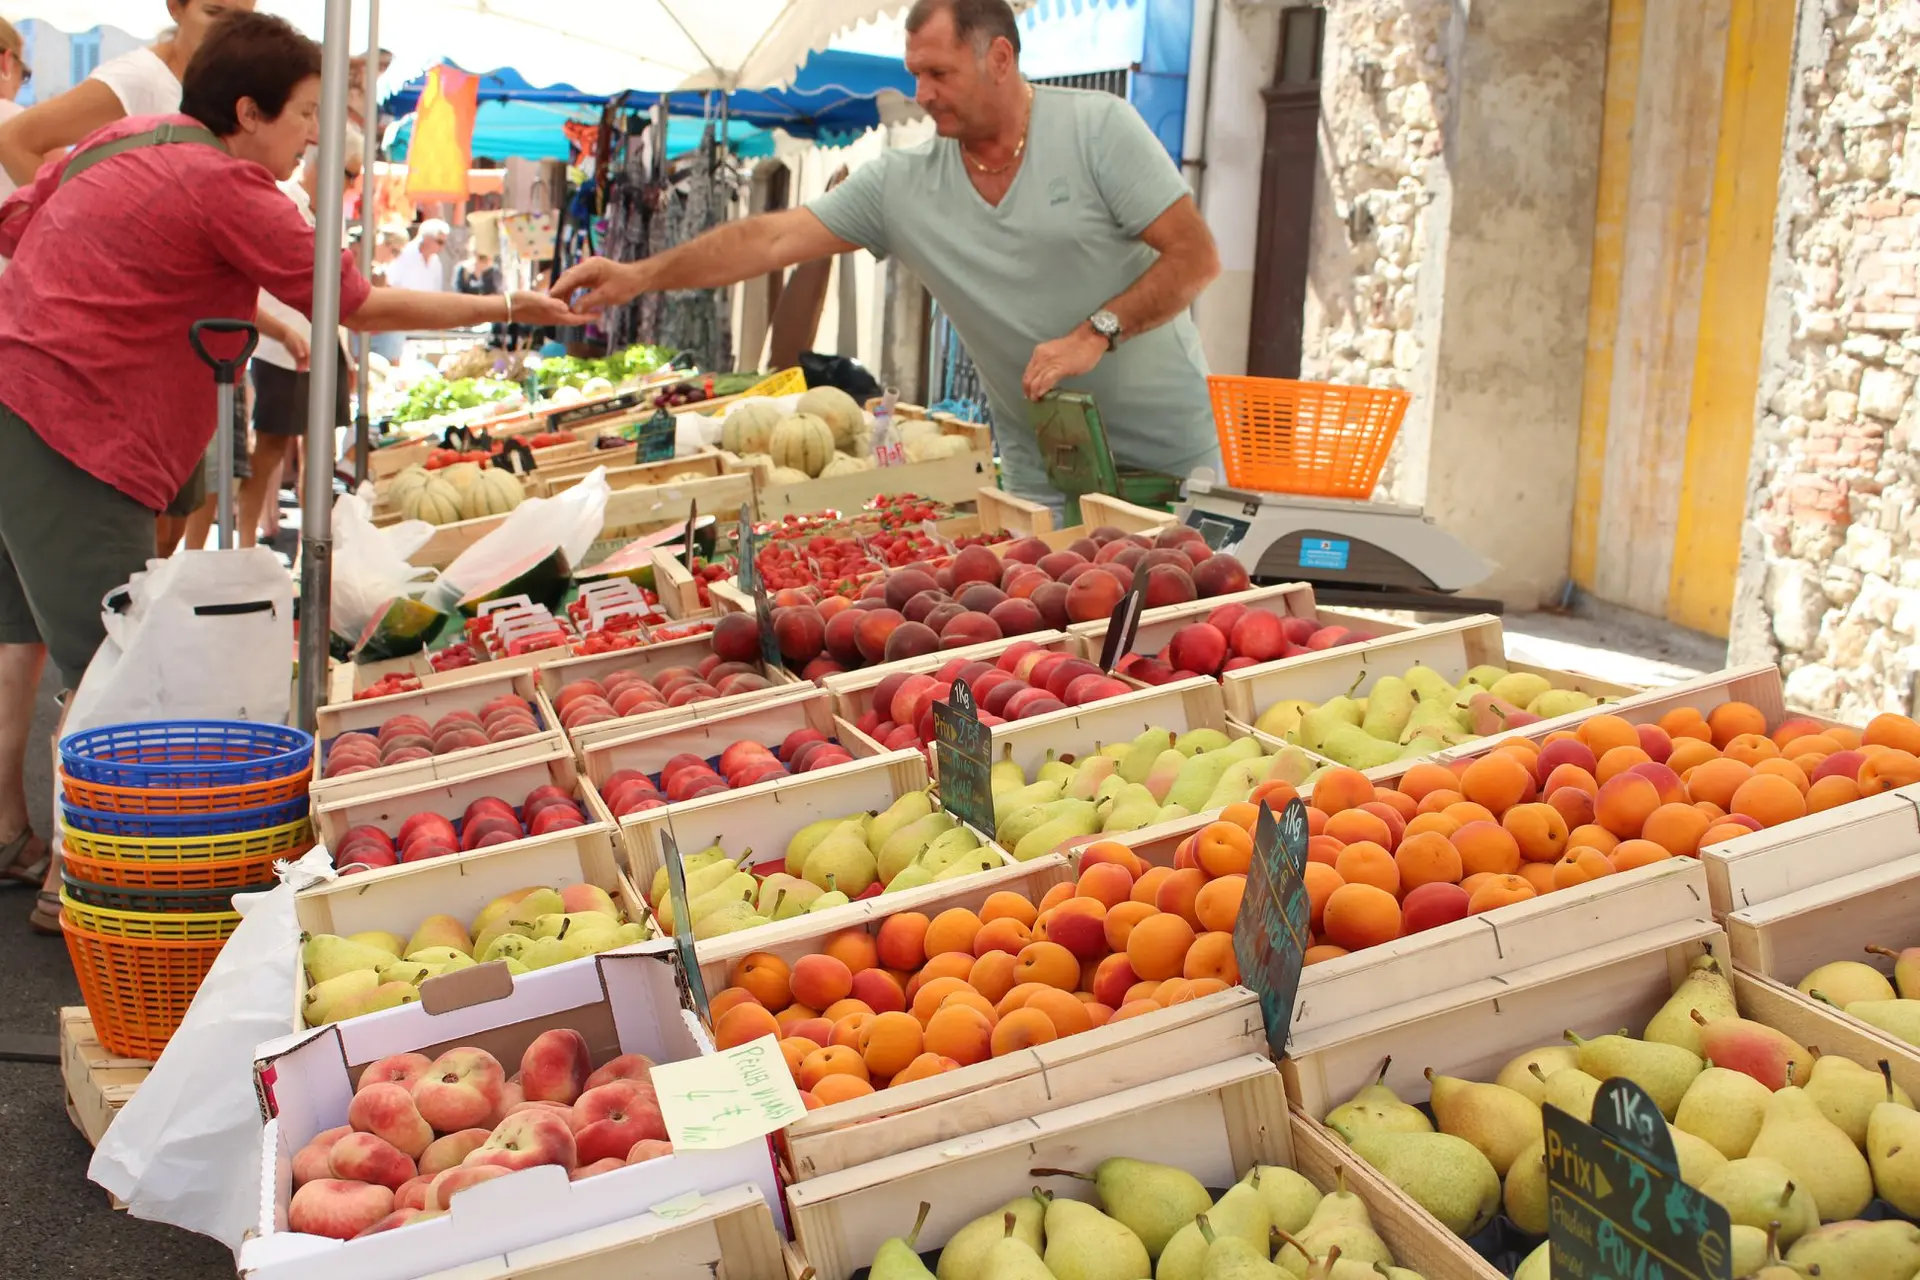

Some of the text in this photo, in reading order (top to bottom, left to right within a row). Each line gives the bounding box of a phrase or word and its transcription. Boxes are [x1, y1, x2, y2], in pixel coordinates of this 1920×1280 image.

[955, 683, 969, 709] 1Kg
[934, 712, 951, 741] Prix
[1285, 803, 1303, 842] 1Kg
[1609, 1087, 1654, 1148] 1Kg
[1547, 1128, 1592, 1193] Prix
